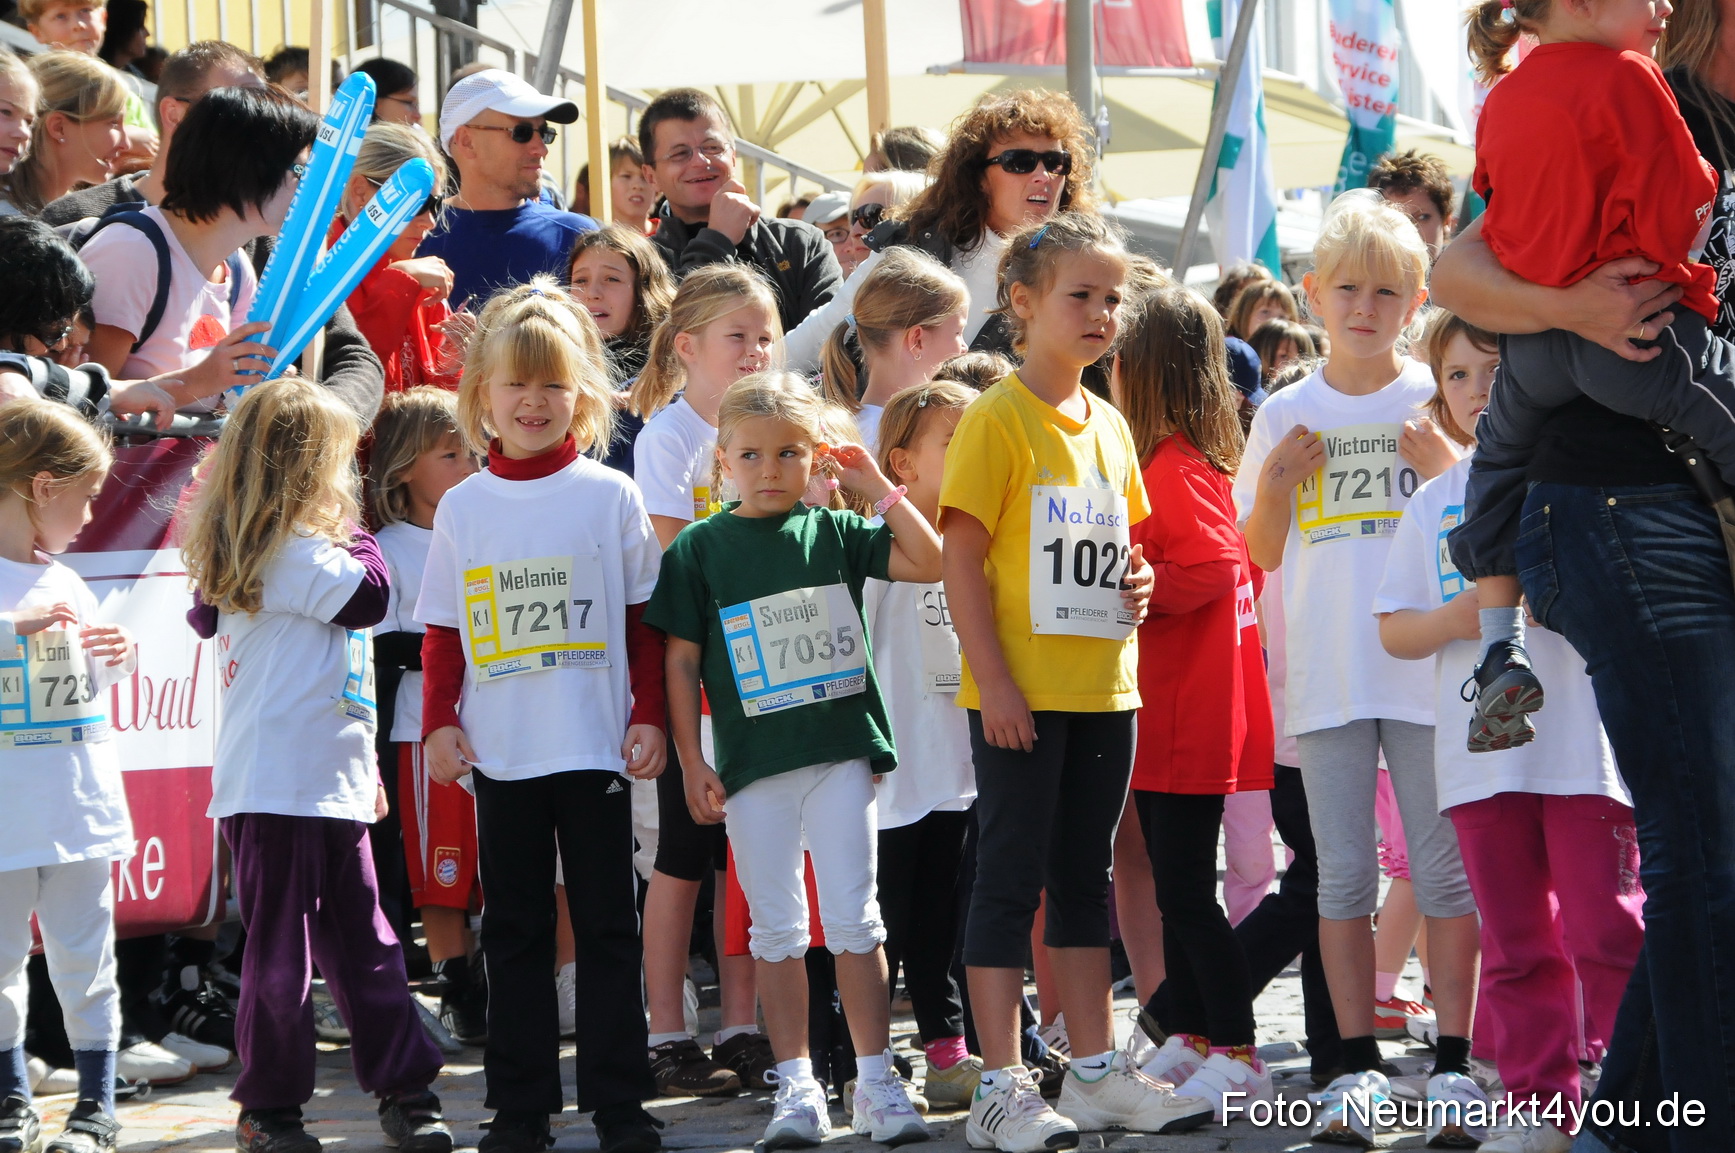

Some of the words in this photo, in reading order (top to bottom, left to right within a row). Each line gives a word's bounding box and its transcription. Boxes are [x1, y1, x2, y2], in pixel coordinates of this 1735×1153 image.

[366, 204, 382, 222] dsl
[1327, 434, 1397, 458] Victoria
[1329, 466, 1418, 502] 7210
[1310, 526, 1341, 540] BOCK
[1043, 537, 1136, 591] 1022
[499, 567, 567, 592] Melanie
[505, 599, 593, 636] 7217
[759, 600, 819, 628] Svenja
[1070, 606, 1108, 618] PFLEIDERER
[35, 641, 71, 662] Loni
[557, 650, 606, 661] PFLEIDERER
[769, 625, 856, 670] 7035
[488, 660, 521, 674] BOCK
[826, 675, 865, 692] PFLEIDERER
[757, 693, 794, 709] BOCK
[346, 704, 371, 719] BOCK
[14, 732, 52, 743] BOCK
